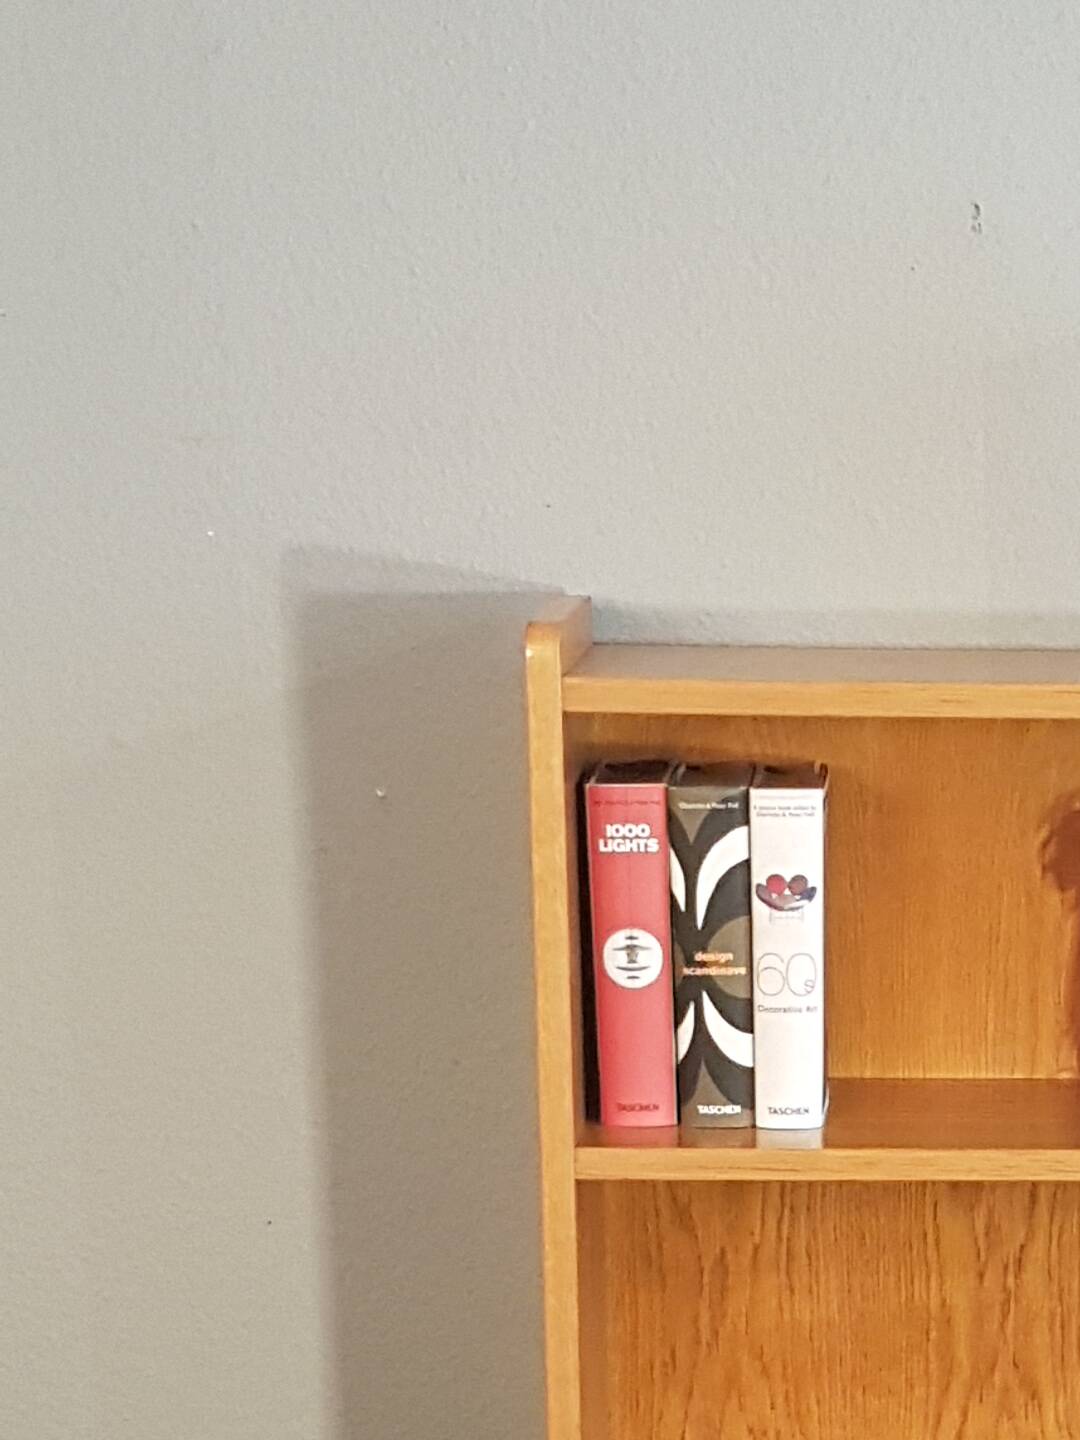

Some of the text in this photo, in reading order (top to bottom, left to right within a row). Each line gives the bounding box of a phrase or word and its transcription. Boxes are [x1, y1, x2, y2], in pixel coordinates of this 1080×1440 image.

[606, 823, 651, 839] 1000
[598, 837, 660, 853] LIGHTS
[693, 950, 734, 963] design
[616, 1102, 660, 1113] TASCHEN
[696, 1104, 742, 1114] TASCHEN
[767, 1106, 810, 1116] TASCHEN
